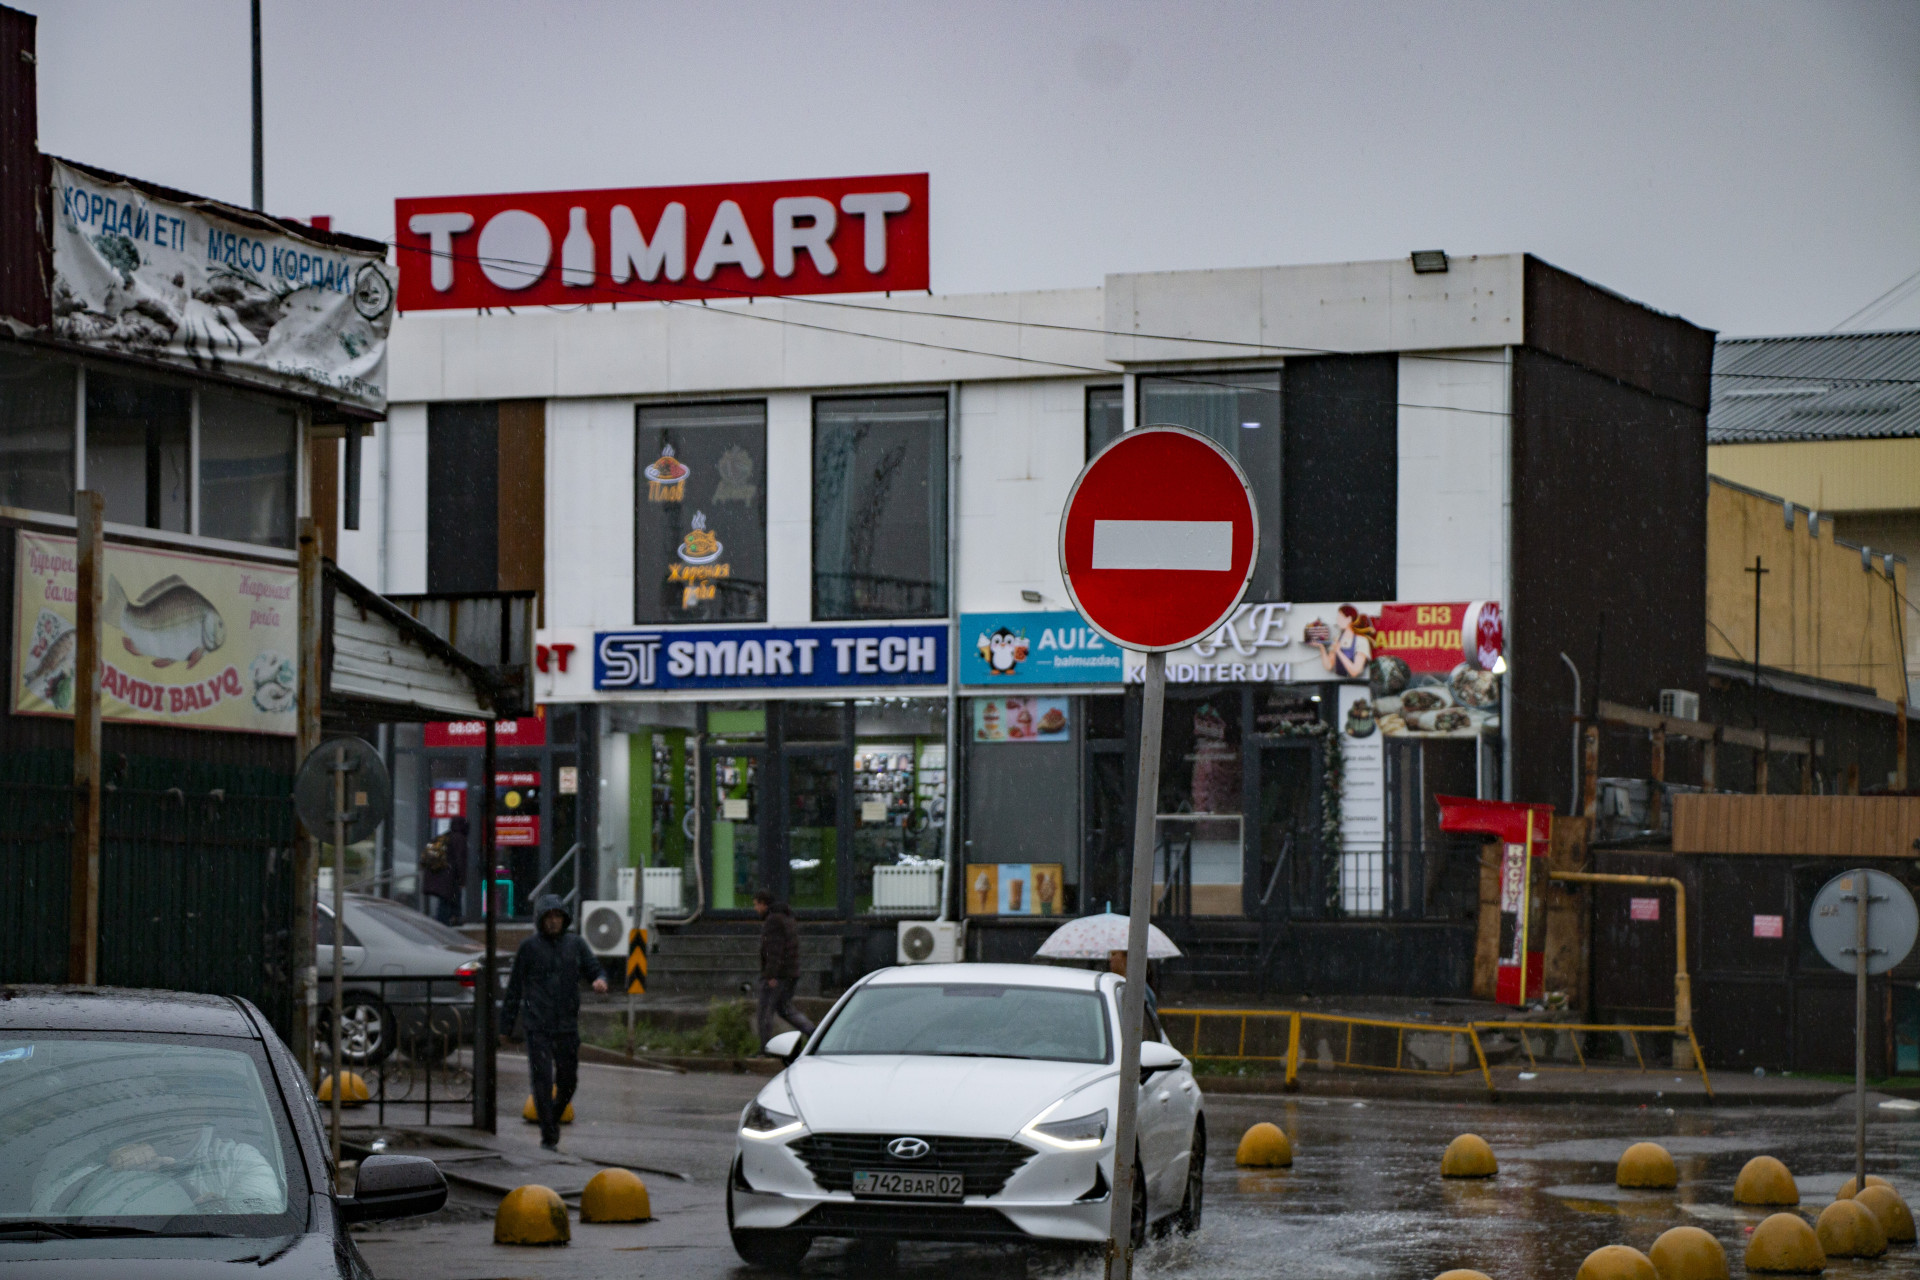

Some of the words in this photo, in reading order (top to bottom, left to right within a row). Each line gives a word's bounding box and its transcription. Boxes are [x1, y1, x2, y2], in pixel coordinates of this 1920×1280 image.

[208, 226, 267, 273] МЯСО
[272, 246, 351, 293] КОРДАЙ
[648, 480, 686, 502] Плов
[1038, 627, 1106, 651] AUIZ
[1192, 602, 1292, 659] KE
[1375, 629, 1462, 650] АШЫЛД
[667, 637, 819, 678] SMART
[832, 636, 936, 675] TECH
[1054, 655, 1121, 669] balmuzdaq
[1129, 663, 1249, 684] KNDITER
[101, 664, 165, 712] AMDI
[168, 666, 243, 713] BALYQ
[940, 1176, 961, 1194] 02
